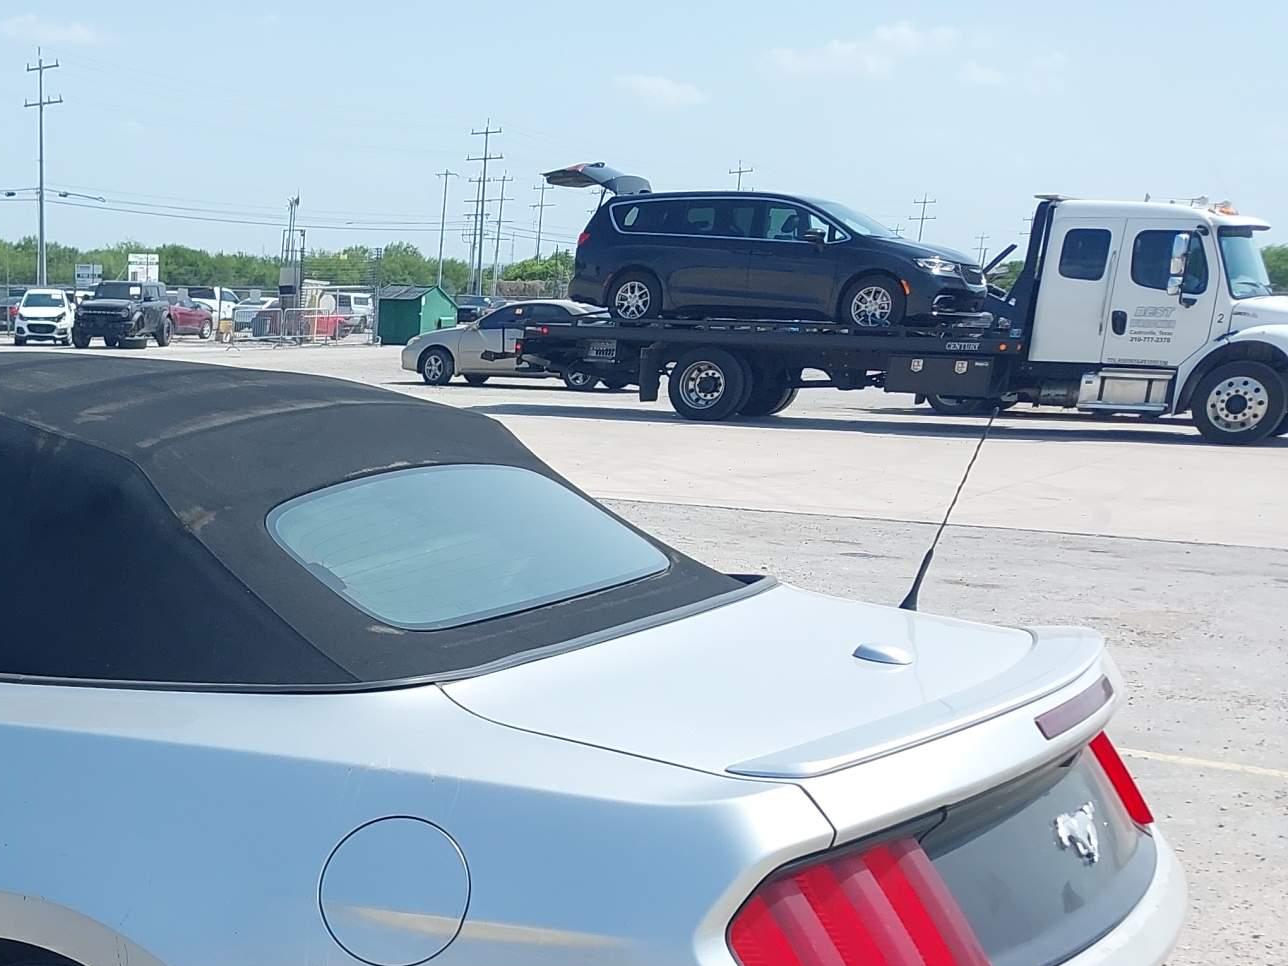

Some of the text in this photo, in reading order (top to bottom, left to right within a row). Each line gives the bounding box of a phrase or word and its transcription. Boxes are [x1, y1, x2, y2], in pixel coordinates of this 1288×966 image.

[1134, 306, 1176, 318] BEST
[1216, 313, 1225, 324] 2
[945, 342, 980, 351] CENTURY
